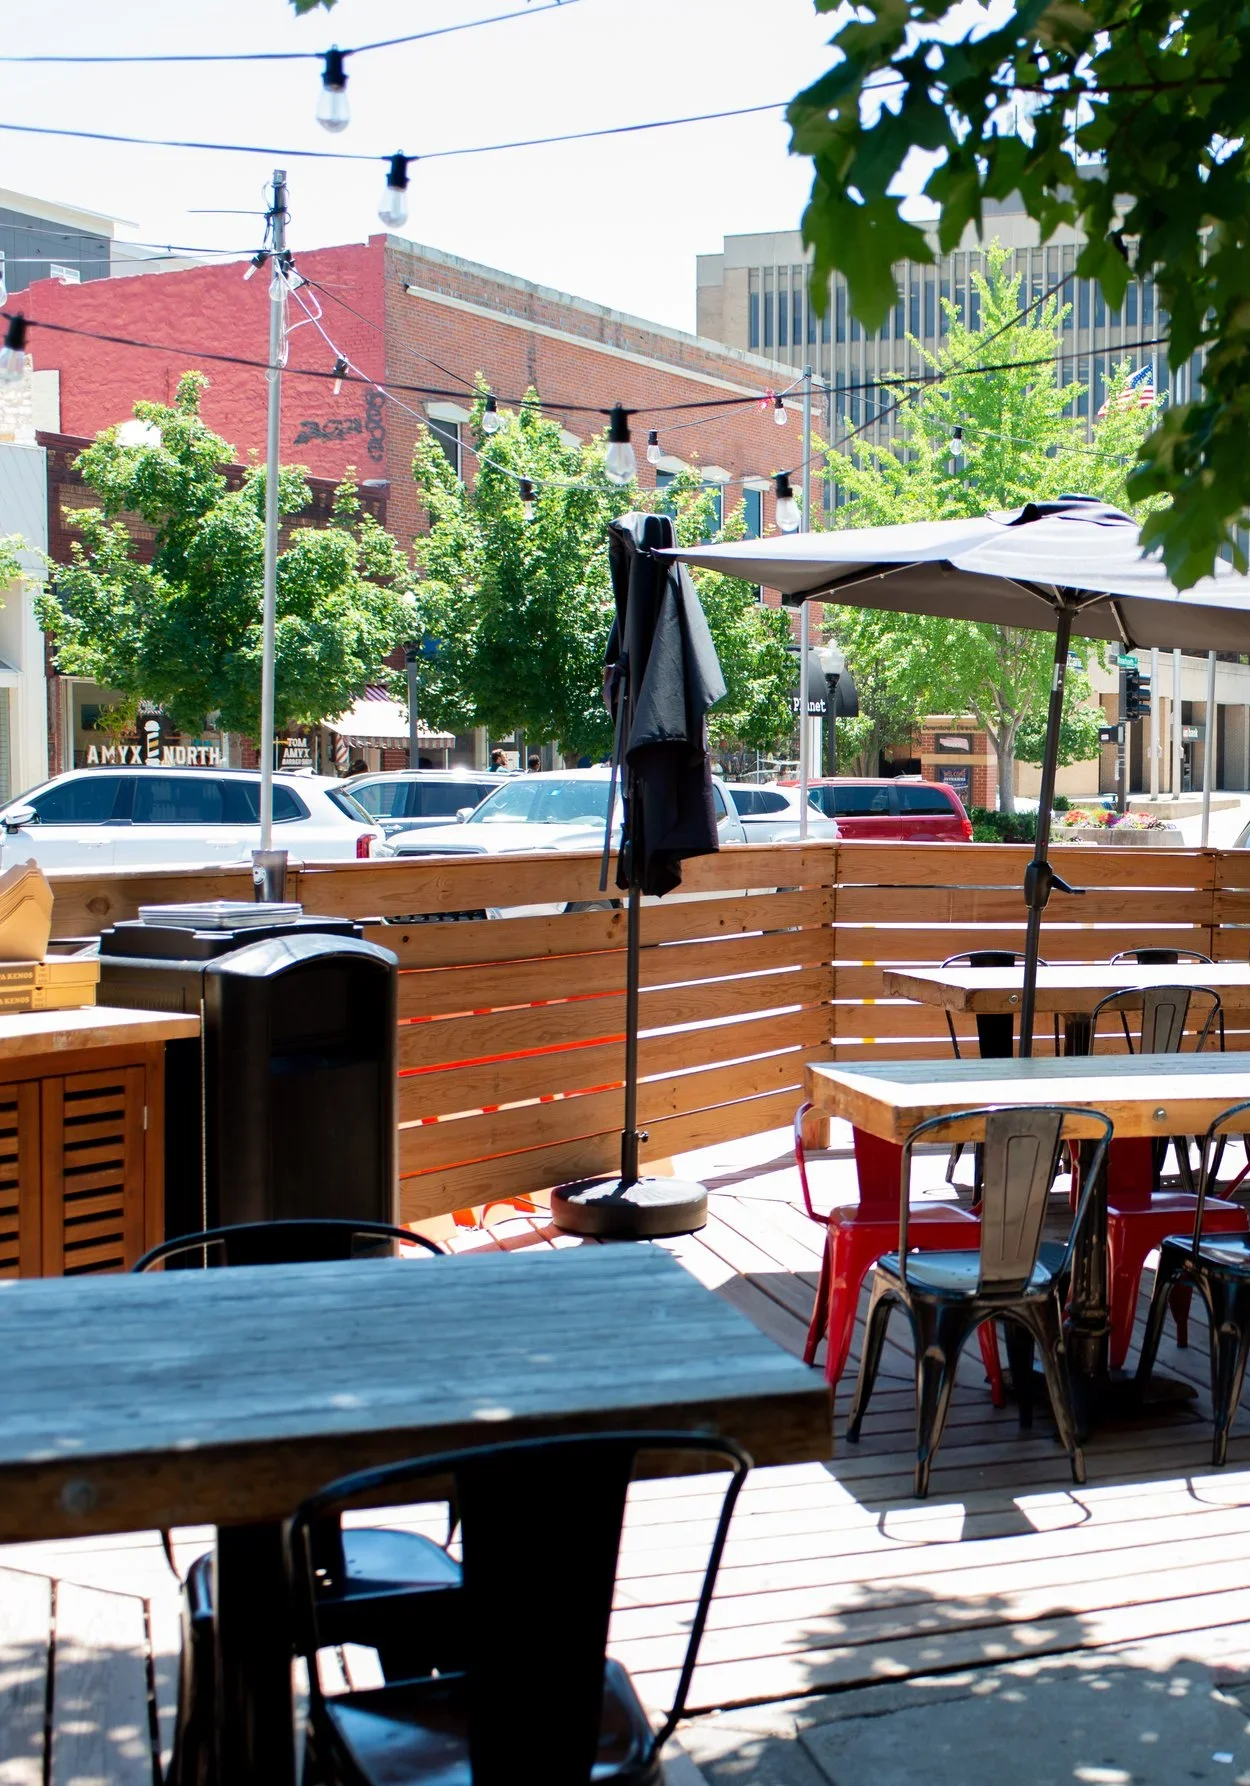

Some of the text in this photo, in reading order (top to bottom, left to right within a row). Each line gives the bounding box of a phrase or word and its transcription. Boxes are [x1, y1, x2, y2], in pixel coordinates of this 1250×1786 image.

[793, 697, 827, 713] Pnet
[287, 738, 307, 747] TOM
[87, 745, 220, 765] AMYX NORTH
[283, 748, 310, 758] AMYX
